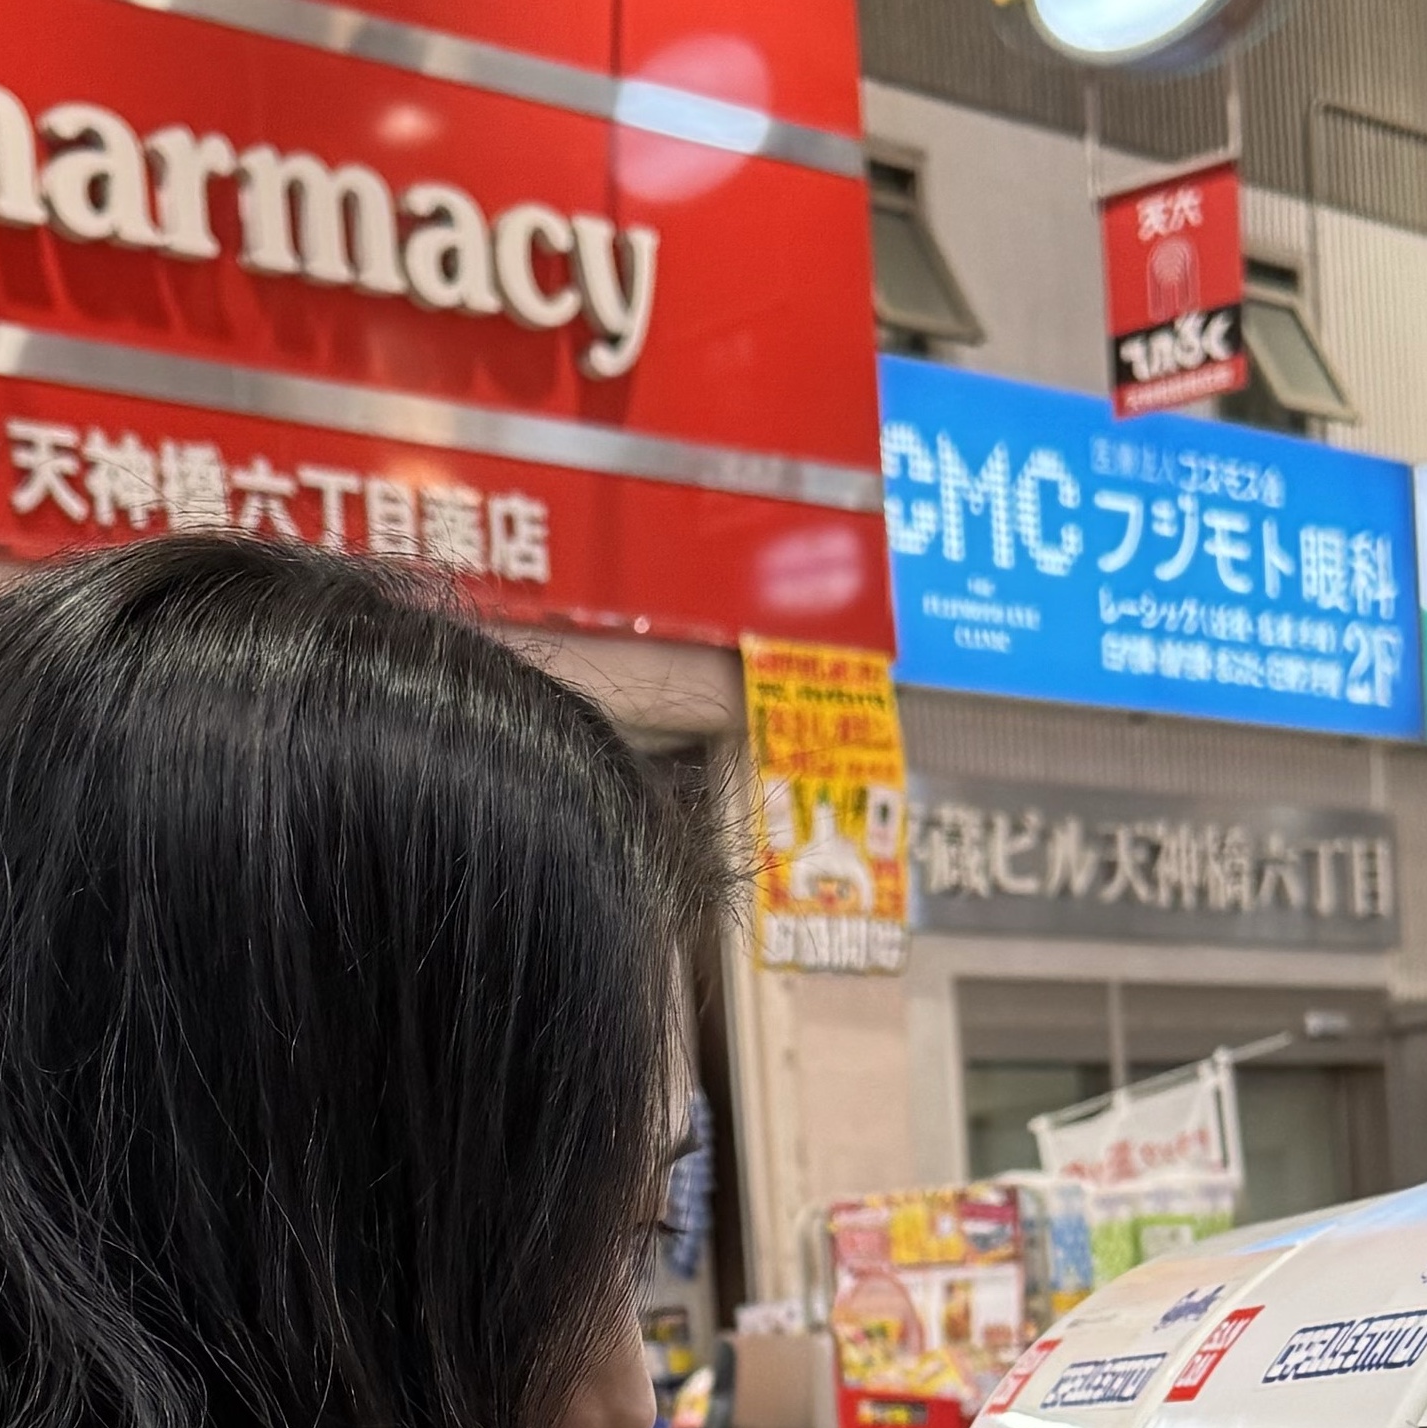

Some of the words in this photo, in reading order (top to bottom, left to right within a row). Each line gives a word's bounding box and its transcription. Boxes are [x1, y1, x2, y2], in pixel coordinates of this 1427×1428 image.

[1095, 490, 1396, 618] フジモト眼科
